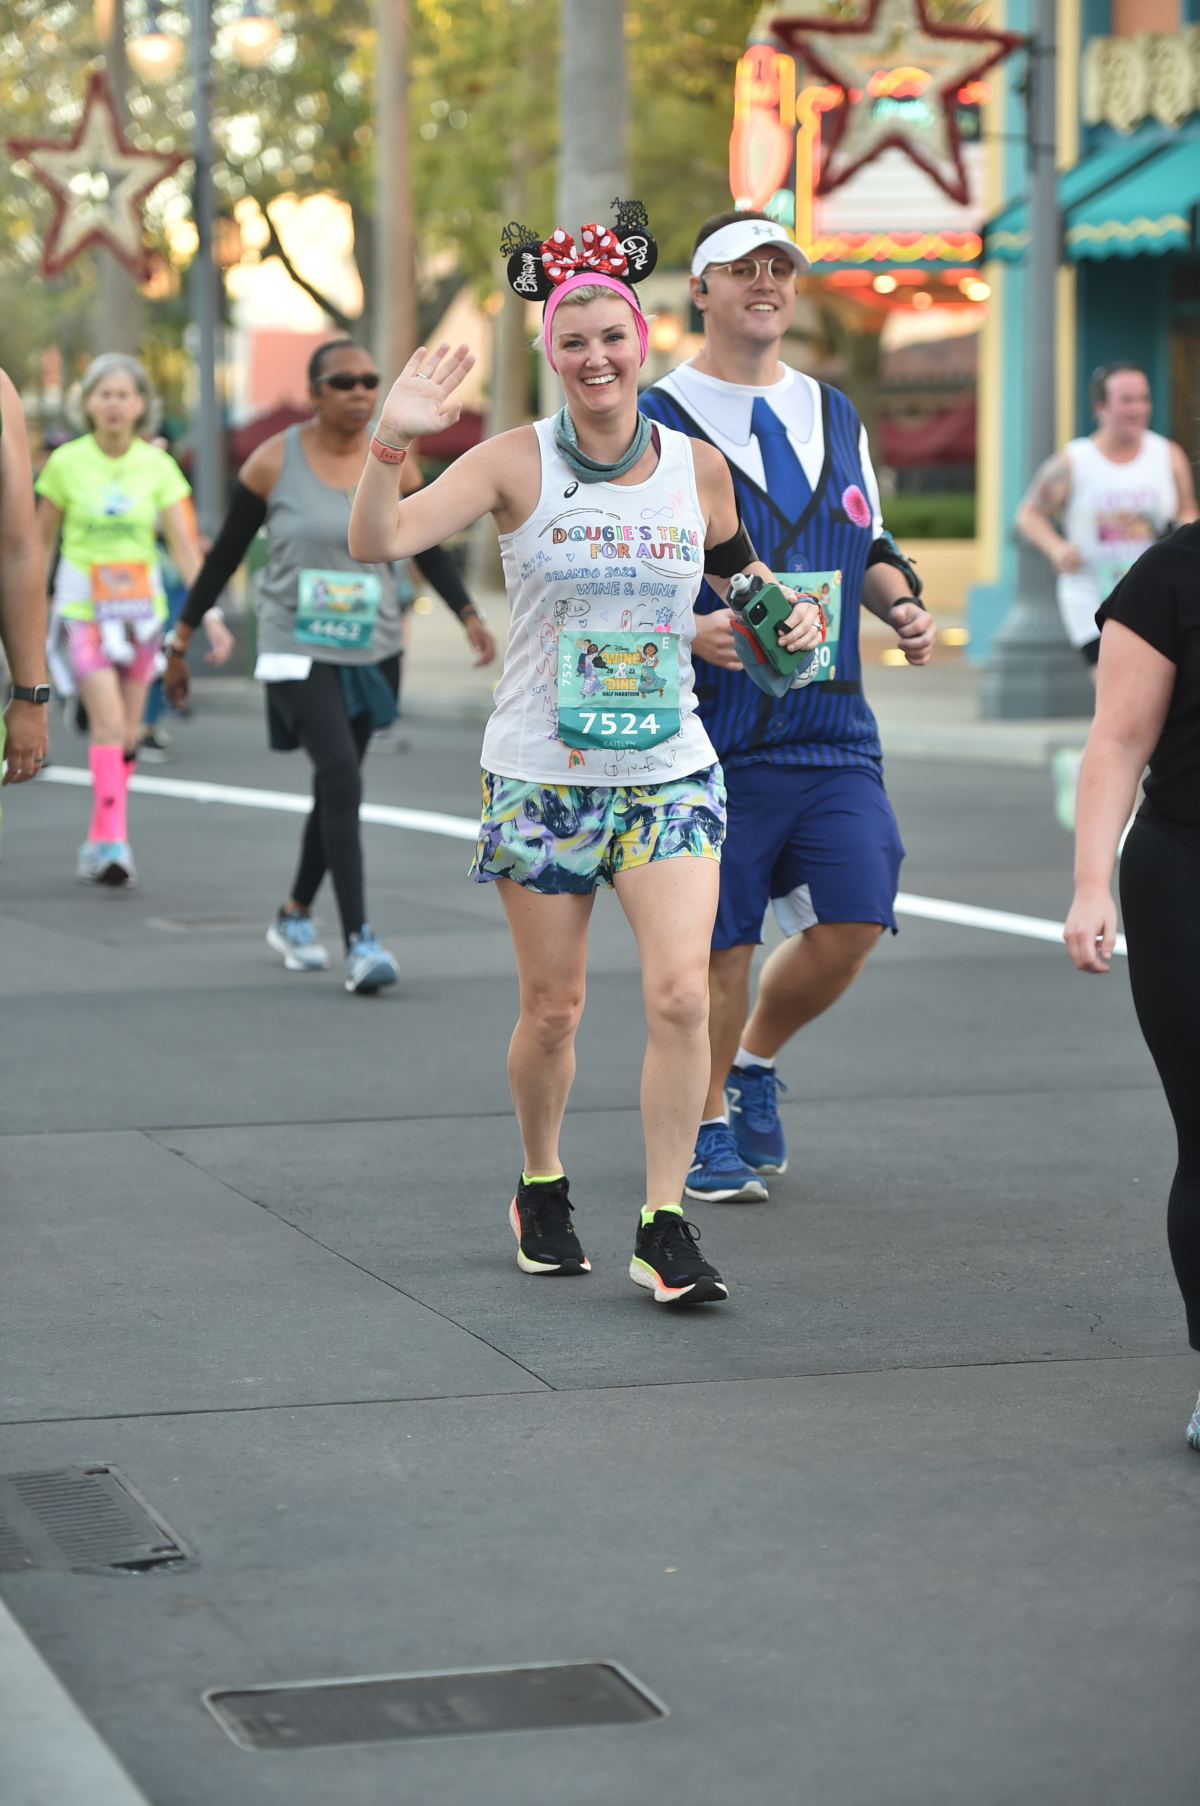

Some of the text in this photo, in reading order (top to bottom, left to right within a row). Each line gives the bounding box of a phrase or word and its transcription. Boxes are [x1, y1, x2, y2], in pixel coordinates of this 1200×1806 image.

[615, 213, 649, 227] 1983
[553, 526, 698, 547] DOUGIE'S TEAM
[590, 543, 701, 564] FOR AUTISM
[544, 567, 601, 583] ORLANDO
[604, 566, 637, 578] 2023
[576, 581, 678, 598] WINE & DINE
[308, 619, 361, 641] 4462
[662, 637, 670, 649] E
[601, 652, 640, 665] WINE
[562, 654, 573, 687] 7524
[614, 662, 628, 680] &
[603, 678, 637, 690] DINE
[579, 712, 661, 735] 7524
[603, 740, 636, 748] KAITLYN
